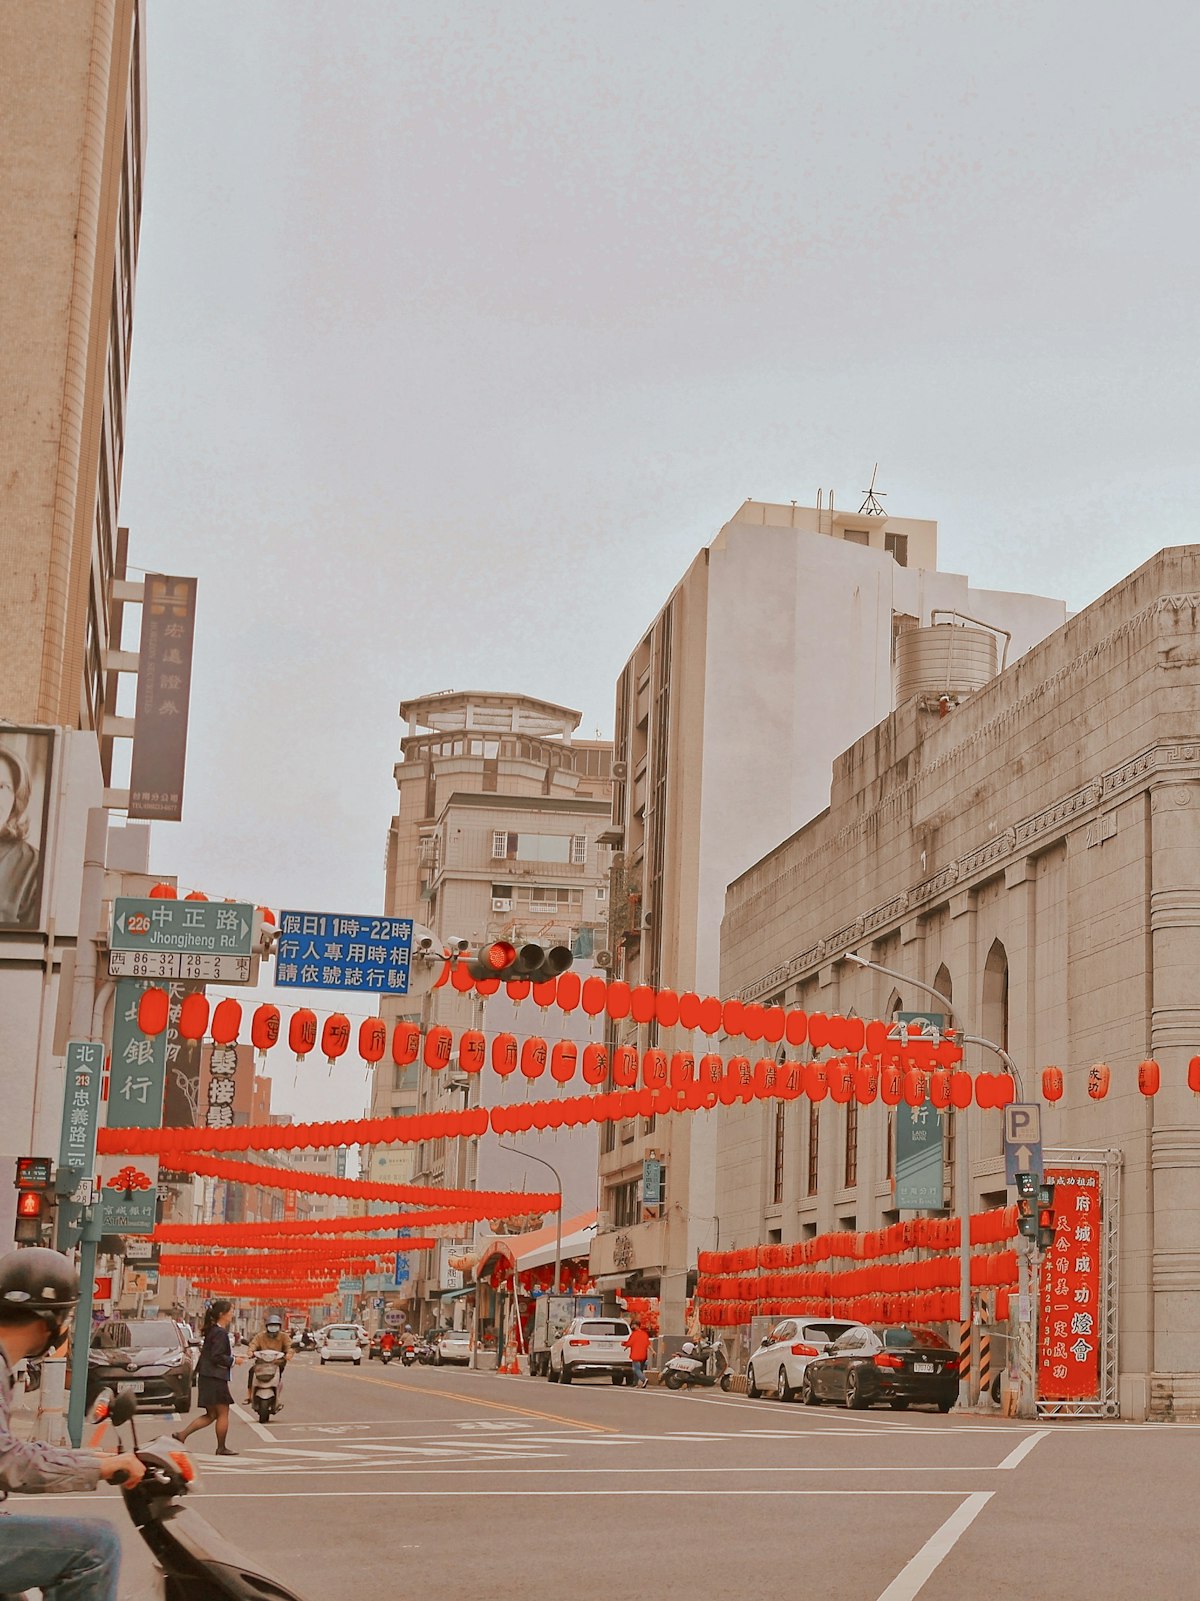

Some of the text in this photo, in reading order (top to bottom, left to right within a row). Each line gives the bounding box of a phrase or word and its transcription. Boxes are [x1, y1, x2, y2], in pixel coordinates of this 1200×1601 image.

[128, 915, 150, 931] 226
[151, 905, 240, 932] 中正路
[150, 931, 239, 950] Jhongjheng Rd.
[112, 952, 126, 965] 西
[133, 953, 174, 965] 86-32
[280, 939, 410, 966] 行人專用時相
[186, 955, 221, 966] 28-2
[235, 957, 250, 972] 東
[132, 965, 174, 978] 89-31
[186, 967, 221, 979] 19-3
[239, 971, 247, 980] E
[278, 963, 407, 989] 請依號誌行駛
[76, 1046, 94, 1062] 北
[75, 1075, 91, 1086] 213
[1011, 1110, 1031, 1138] P
[104, 1216, 129, 1226] ATM
[1069, 1195, 1094, 1363] 府城成功燈會
[1052, 1215, 1072, 1379] 天公作美一定成功
